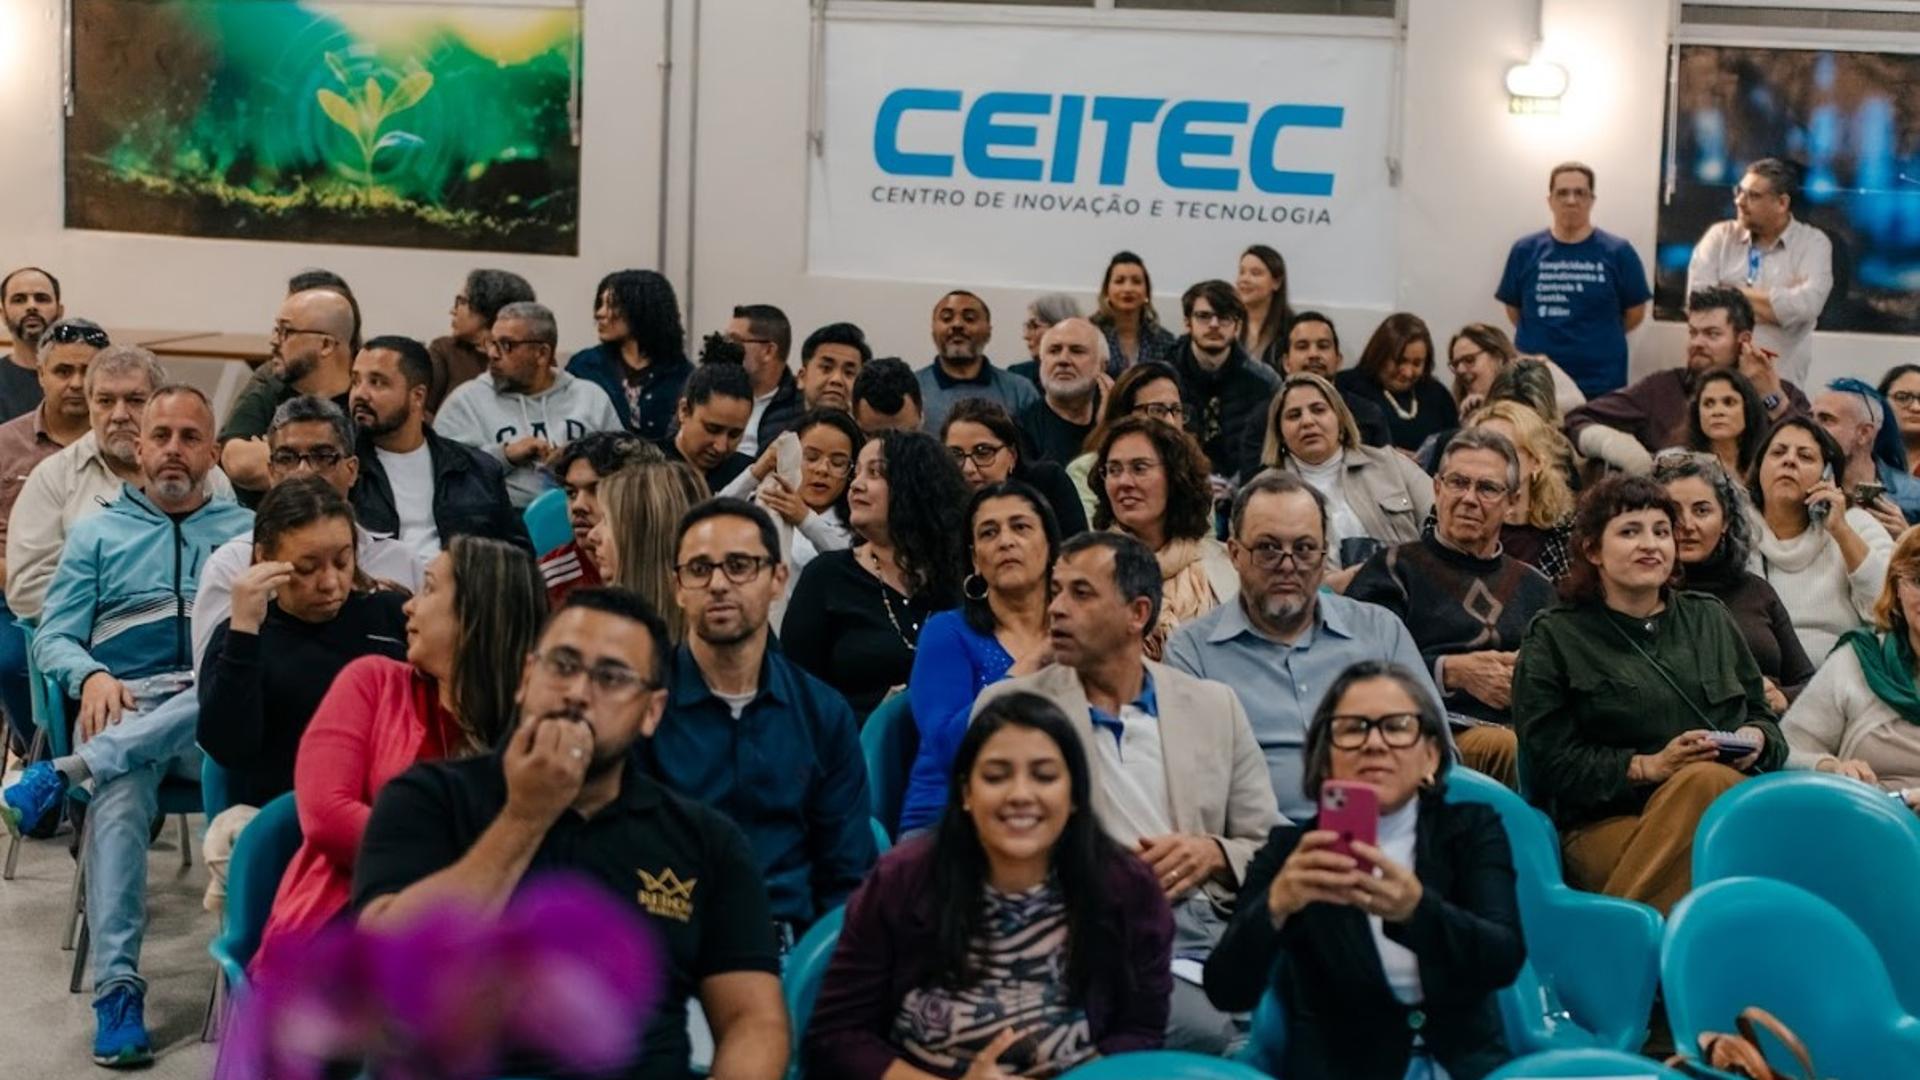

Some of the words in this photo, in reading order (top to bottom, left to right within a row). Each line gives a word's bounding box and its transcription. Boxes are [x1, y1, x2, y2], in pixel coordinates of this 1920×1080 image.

[874, 88, 1345, 196] CEITEC
[871, 186, 965, 206] CENTRO
[974, 191, 1005, 208] DE
[1014, 193, 1141, 217] INOVAÇÃO
[1150, 200, 1163, 217] E
[1175, 201, 1332, 225] TECNOLOGIA
